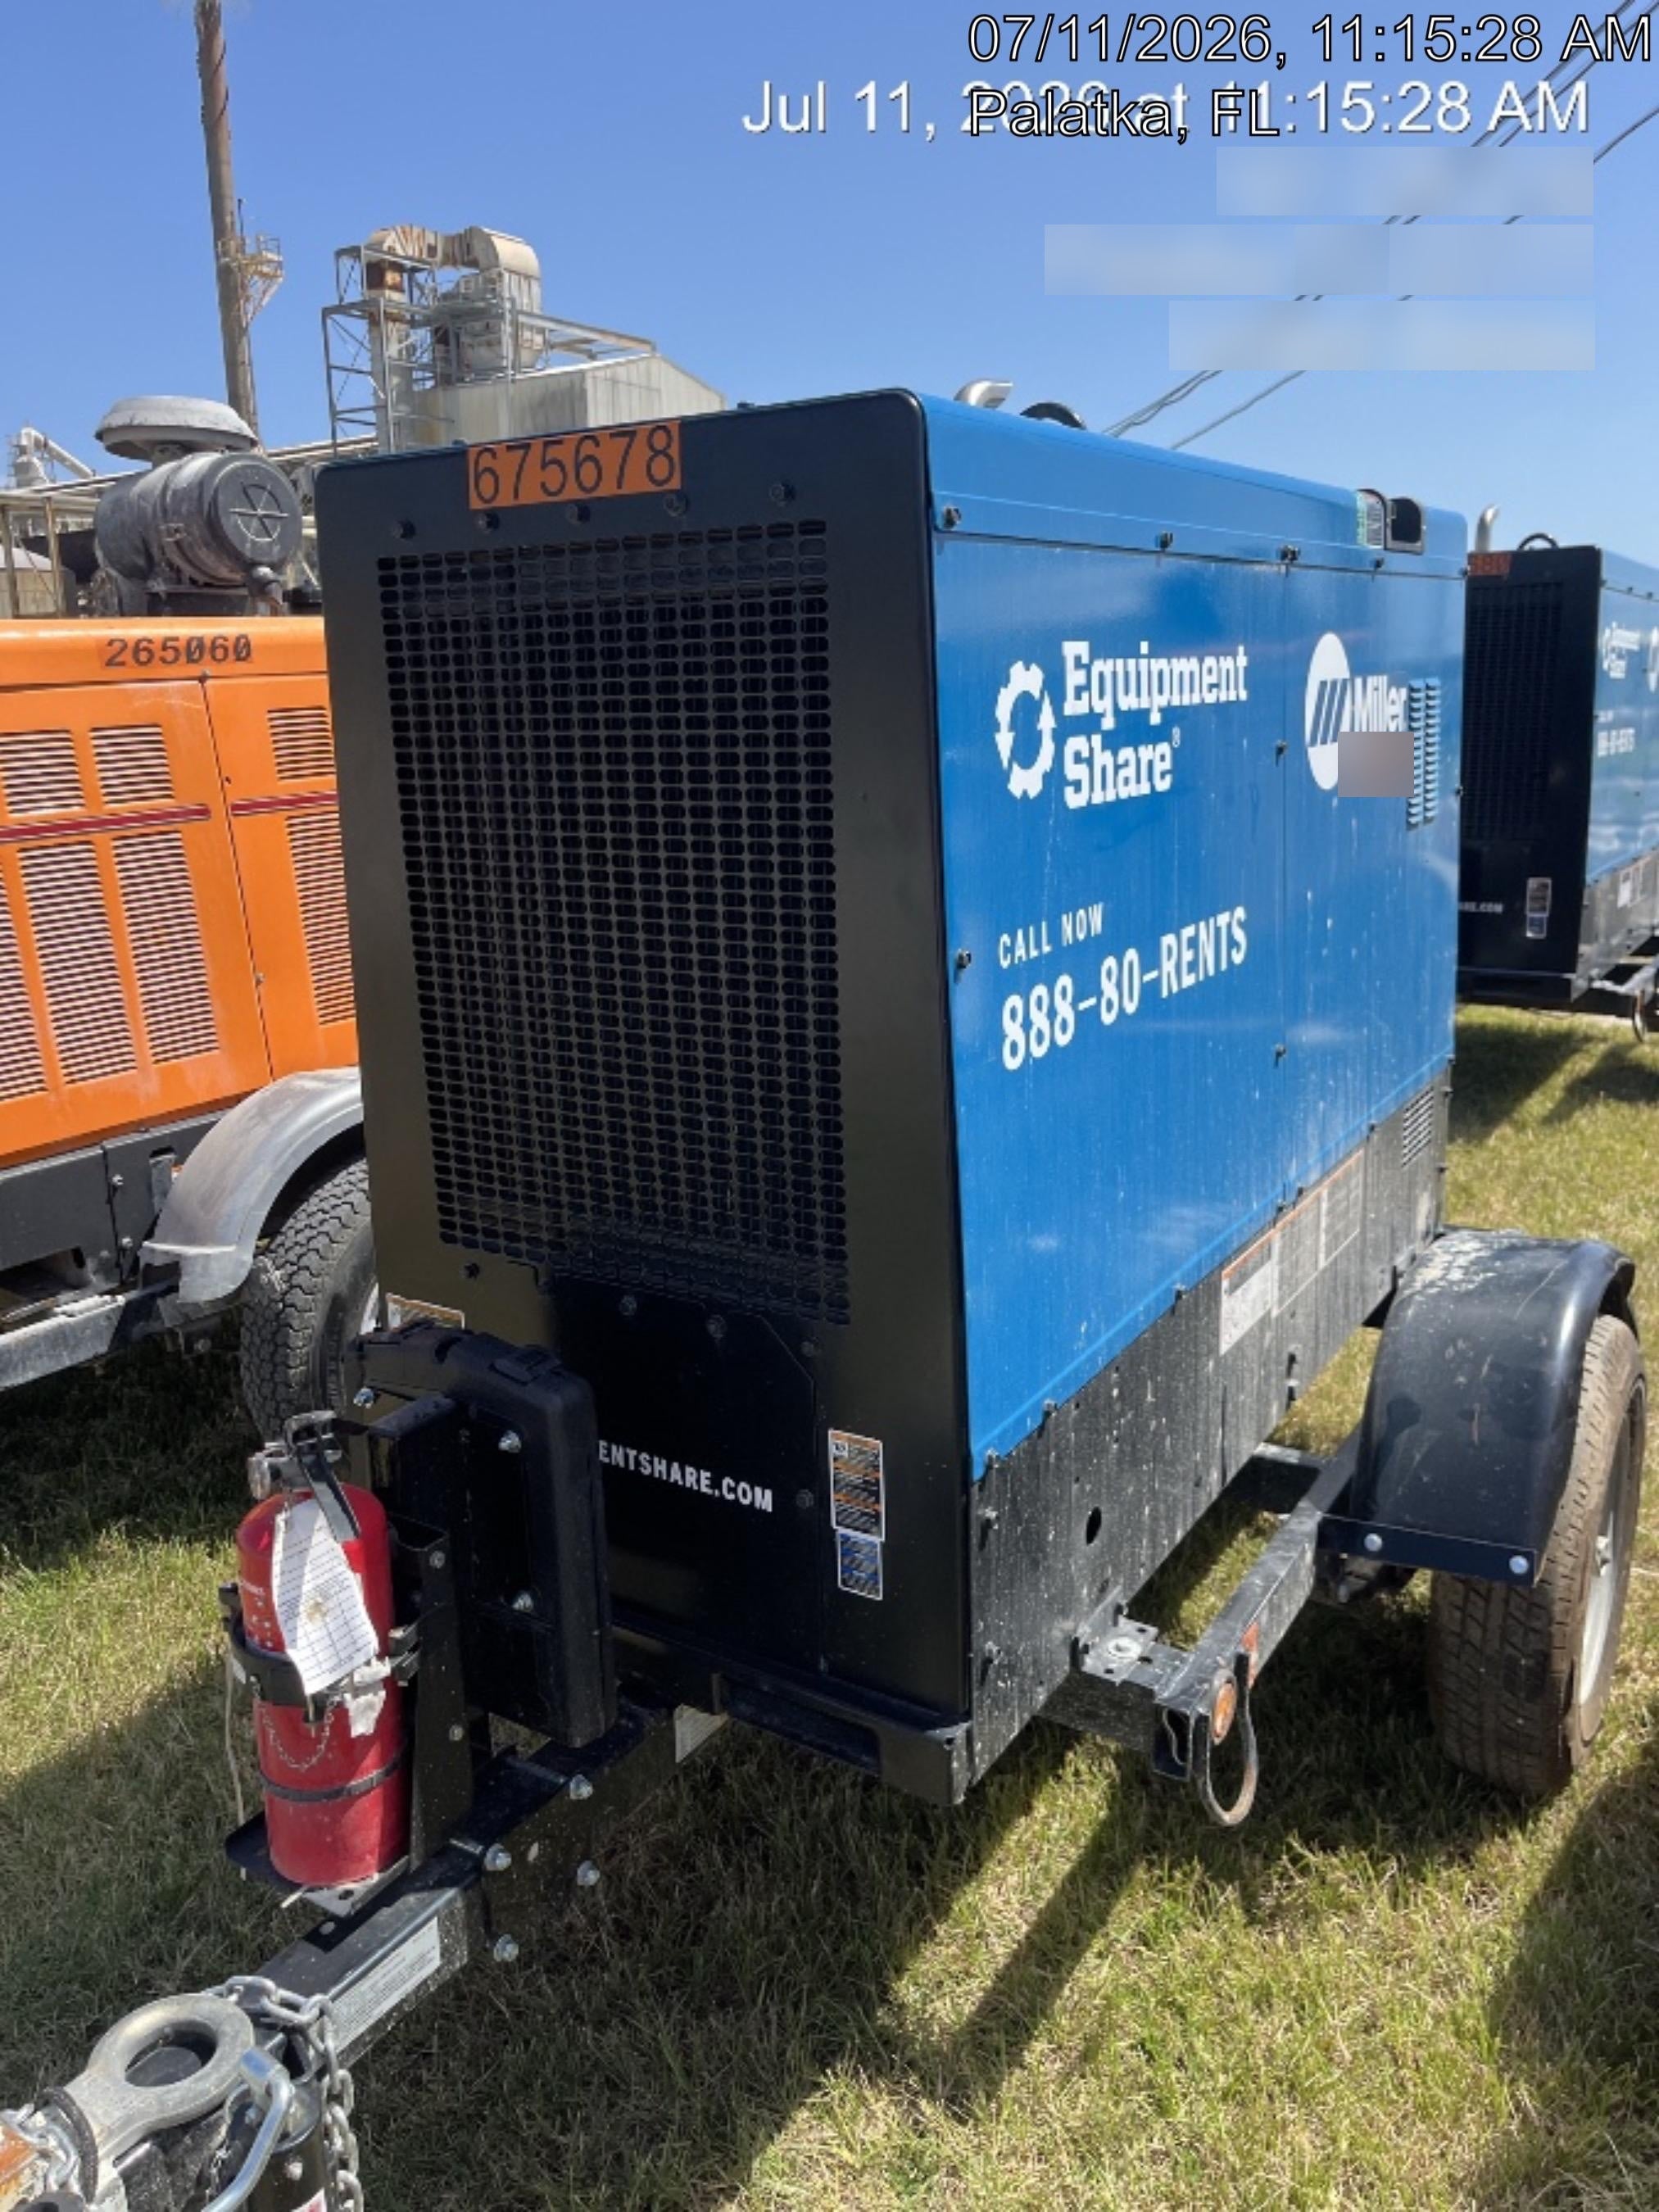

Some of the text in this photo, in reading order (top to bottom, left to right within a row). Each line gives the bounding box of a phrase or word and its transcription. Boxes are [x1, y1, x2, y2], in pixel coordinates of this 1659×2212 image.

[473, 424, 676, 505] 675678
[105, 633, 252, 668] 265060
[1062, 641, 1248, 731] Equipment
[1353, 674, 1408, 732] Miller
[999, 901, 1105, 969] CALL NOW
[1002, 905, 1248, 1072] 888-80-RENTS
[598, 1439, 773, 1512] ENTSHARE.COM
